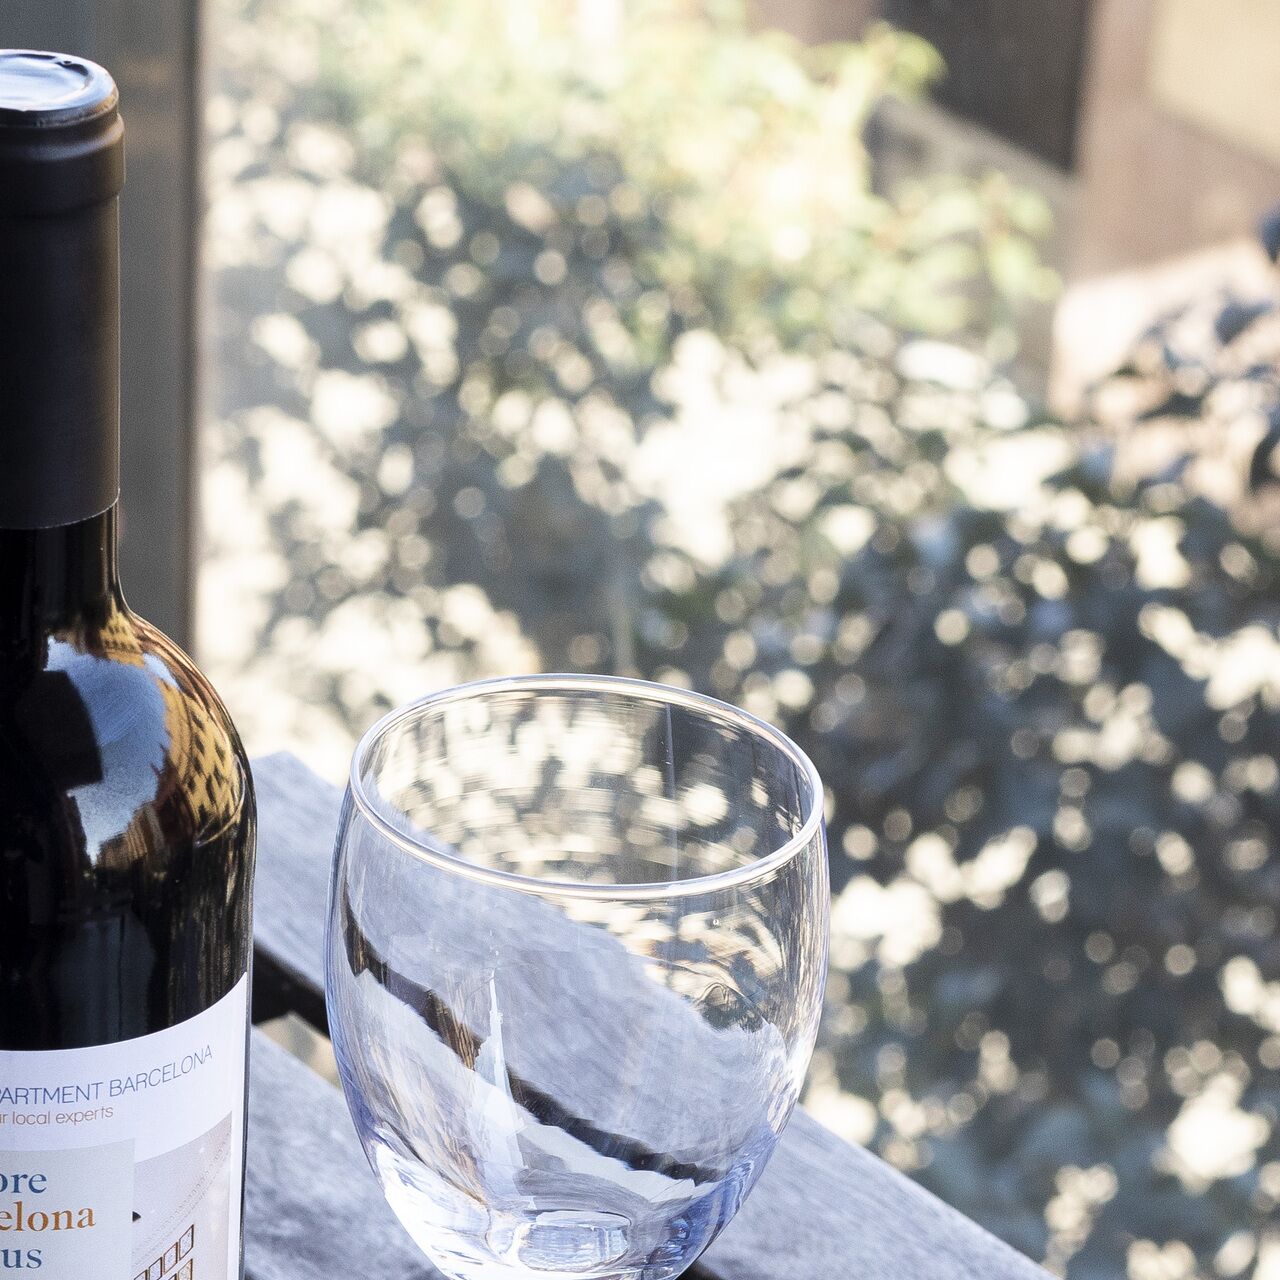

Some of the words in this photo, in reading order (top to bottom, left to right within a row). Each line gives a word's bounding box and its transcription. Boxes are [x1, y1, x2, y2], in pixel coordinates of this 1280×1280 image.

[109, 1045, 214, 1098] BARCELONA
[12, 1110, 51, 1125] local
[55, 1106, 114, 1126] experts
[1, 1248, 42, 1269] us
